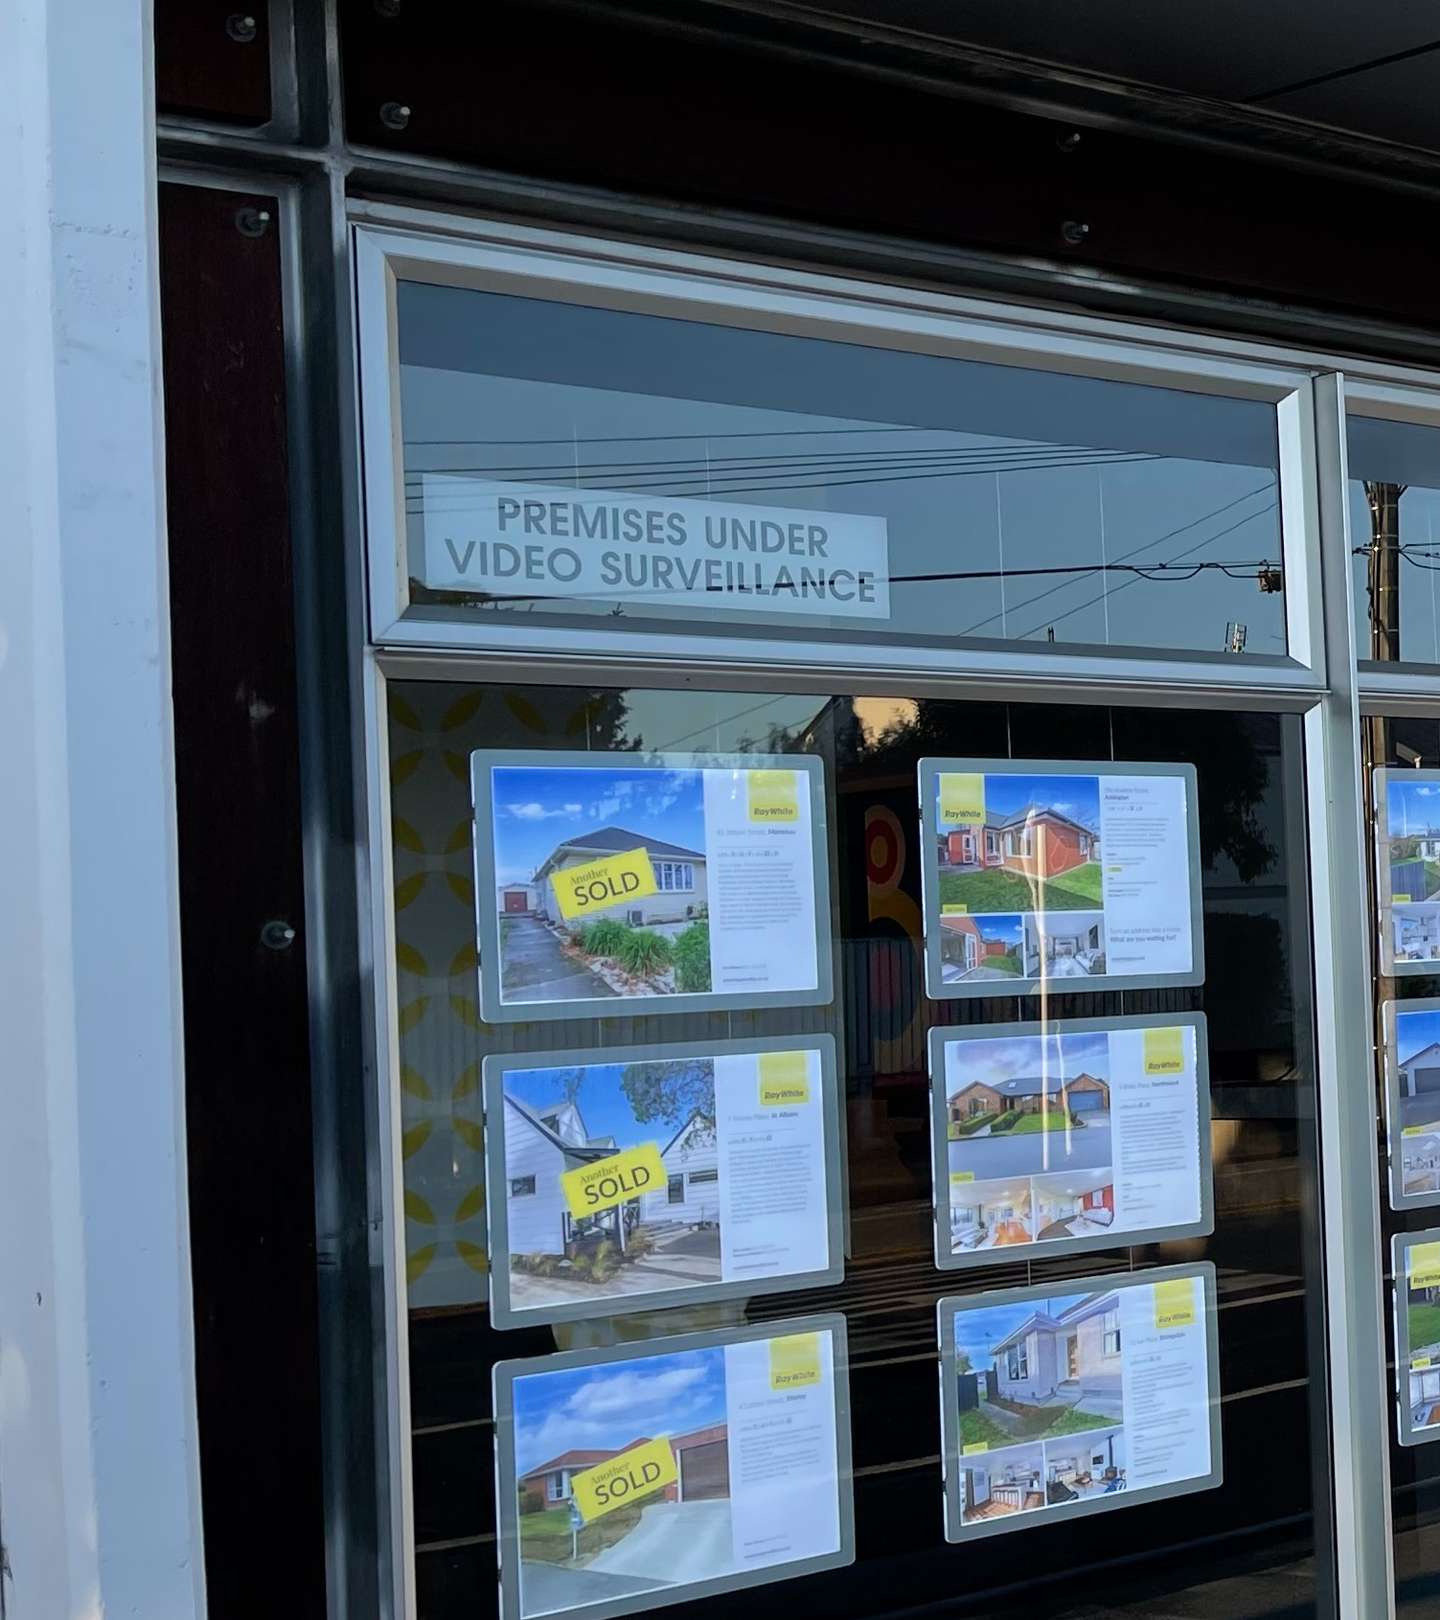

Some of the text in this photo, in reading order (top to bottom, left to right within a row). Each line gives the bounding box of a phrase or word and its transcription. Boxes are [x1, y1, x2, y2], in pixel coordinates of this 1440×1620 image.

[498, 497, 828, 558] PREMISES UNDER
[445, 539, 876, 603] VIDEO SURVEILLANCE
[571, 866, 609, 886] Another
[574, 871, 640, 906] SOLD
[580, 1164, 619, 1185] Another
[583, 1166, 650, 1206] SOLD
[591, 1461, 630, 1485] Another
[594, 1462, 661, 1506] SOLD
